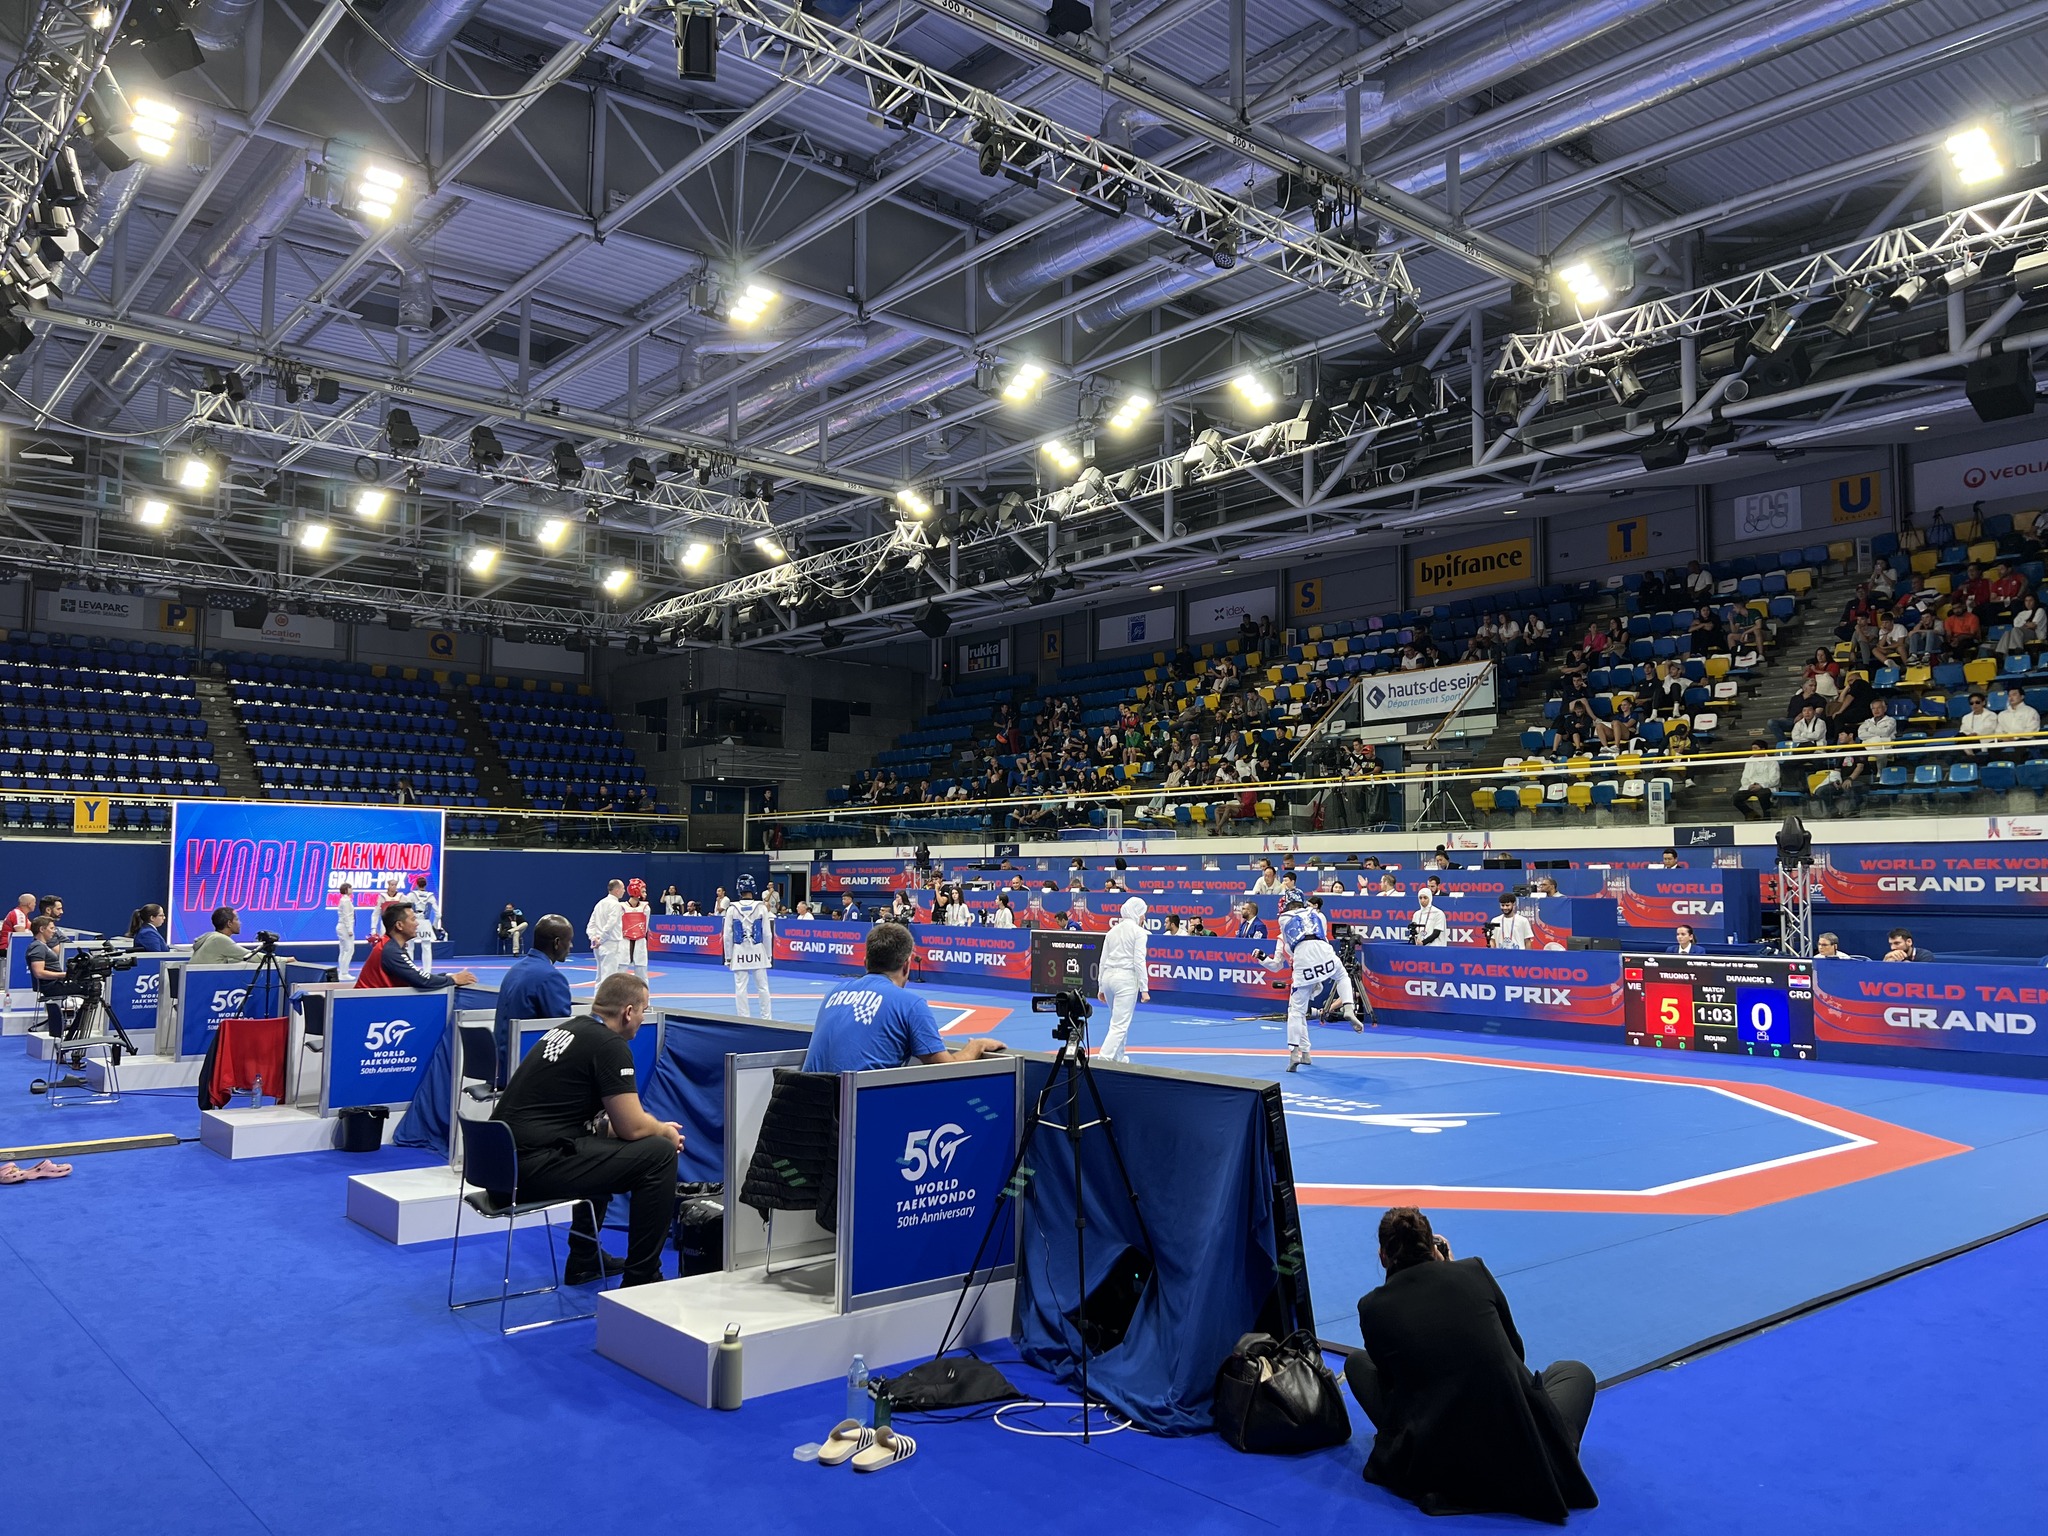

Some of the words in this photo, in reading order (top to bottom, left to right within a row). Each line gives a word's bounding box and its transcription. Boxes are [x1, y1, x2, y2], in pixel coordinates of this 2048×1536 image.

[1233, 136, 1246, 148] 300
[85, 318, 101, 328] 350
[1839, 476, 1870, 513] U
[1617, 521, 1637, 552] T
[1421, 549, 1522, 587] bpifrance
[1301, 582, 1315, 608] S
[78, 600, 129, 613] LEVAPARC
[1225, 605, 1246, 617] idex
[167, 603, 187, 626] P
[261, 628, 301, 639] Location
[430, 633, 453, 656] Q
[969, 642, 999, 659] rukka
[1048, 633, 1058, 653] R
[1387, 696, 1439, 709] Département
[1440, 691, 1464, 703] Sporti
[83, 801, 101, 822] Y
[331, 842, 433, 871] TAEKWONDO
[836, 867, 855, 875] WORLD
[857, 866, 896, 875] TAEKWONDO
[1860, 858, 1937, 871] WORLD
[184, 838, 329, 912] WORLD
[840, 876, 869, 885] GRAND
[871, 876, 890, 885] PRIX
[1138, 880, 1175, 889] WORLD
[1177, 880, 1247, 890] TAEKWONDO
[1657, 883, 1724, 894] WORLD
[1877, 876, 1986, 892] GRAND
[1330, 908, 1383, 920] WORLD
[656, 924, 676, 932] WORLD
[677, 924, 715, 933] TAEKWONDO
[785, 928, 810, 938] WORLD
[812, 929, 861, 941] TAEKWONDO
[659, 934, 688, 945] GRAND
[688, 935, 708, 946] PRIX
[789, 940, 826, 953] GRAND
[828, 943, 855, 955] PRIX
[921, 935, 953, 946] WORLD
[955, 937, 1016, 950] TAEKWONDO
[1066, 942, 1083, 950] REPLAY
[737, 953, 762, 964] HUN
[927, 949, 972, 963] GRAND
[974, 952, 1007, 967] PRIX
[1147, 947, 1185, 959] ORLD
[1047, 959, 1057, 978] 3
[1089, 962, 1099, 981] 0
[1148, 963, 1214, 981] GRAND
[1219, 968, 1267, 985] PRIX
[1390, 960, 1455, 975] WORLD
[1460, 963, 1589, 981] TAEKWONDO
[1659, 972, 1689, 980] TRUONG
[1627, 982, 1642, 990] VIE
[1726, 975, 1765, 984] DUVANCIC
[1404, 979, 1497, 1001] GRAND
[1504, 985, 1572, 1006] PRIX
[1705, 993, 1723, 1003] 117
[1789, 990, 1812, 999] CRO
[1858, 981, 1966, 1000] WORLD
[825, 990, 883, 1016] CROATIA
[1660, 997, 1680, 1025] 5
[1697, 1006, 1733, 1022] 1:03
[1751, 1002, 1773, 1031] 0
[1883, 1006, 2037, 1035] GRAND
[1633, 1037, 1640, 1046] 0
[1704, 1034, 1728, 1043] ROUND
[374, 1050, 406, 1058] WORLD
[1713, 1043, 1718, 1051] 1
[1799, 1050, 1806, 1059] 0
[360, 1056, 418, 1066] TAEKWONDO
[360, 1066, 376, 1075] 50th
[377, 1065, 417, 1074] Anniversary
[915, 1178, 959, 1196] WORLD
[896, 1188, 976, 1213] TAEKWONDO
[896, 1215, 919, 1229] 50th
[920, 1205, 976, 1225] Anniversary
